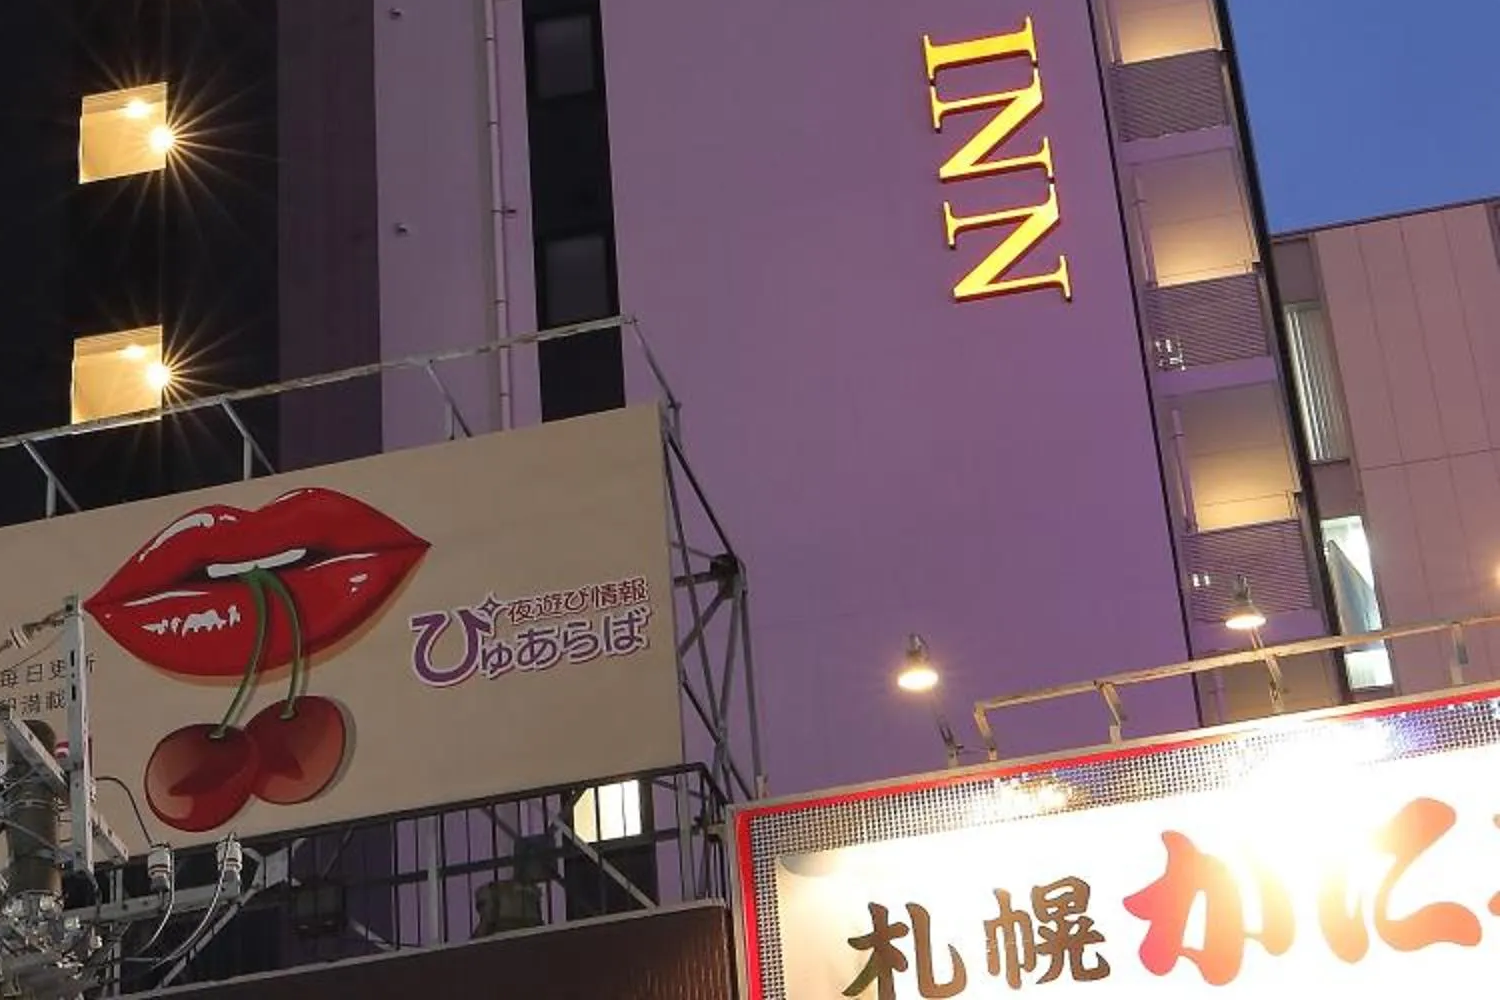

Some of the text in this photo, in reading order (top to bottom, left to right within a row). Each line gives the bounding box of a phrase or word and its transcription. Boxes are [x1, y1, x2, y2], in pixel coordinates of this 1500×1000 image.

[922, 16, 1071, 302] INN
[506, 577, 647, 622] 夜遊び情報
